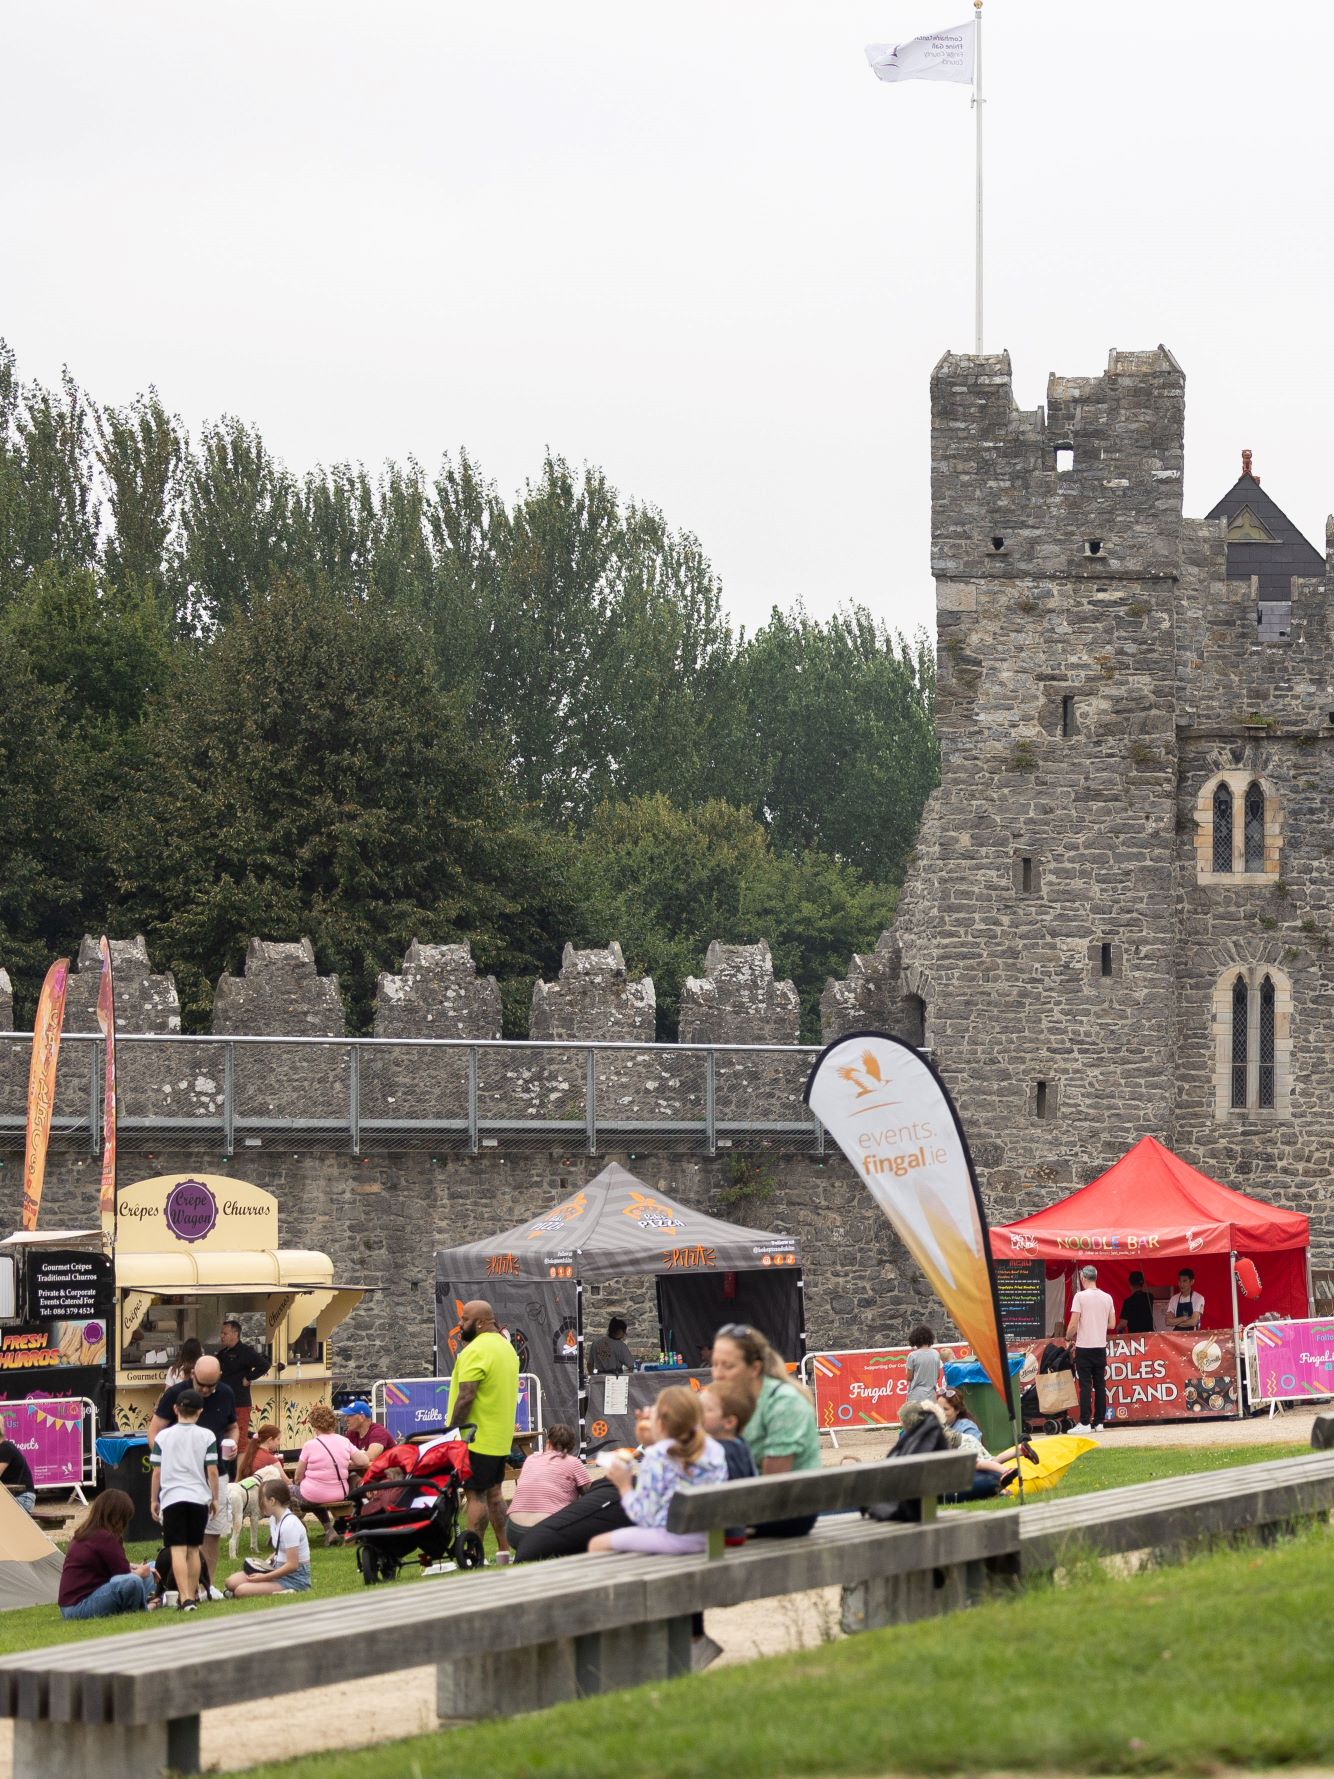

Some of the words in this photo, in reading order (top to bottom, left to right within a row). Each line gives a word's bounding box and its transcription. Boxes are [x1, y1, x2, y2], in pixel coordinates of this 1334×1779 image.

[858, 1121, 938, 1149] events.
[862, 1144, 949, 1177] fingal.ie
[119, 1201, 159, 1221] Crêpes
[223, 1200, 271, 1216] Churros
[170, 1209, 212, 1229] Wagon
[638, 1219, 687, 1229] PIZZA
[1057, 1235, 1121, 1250] NOODLE
[1127, 1234, 1160, 1249] BAR
[41, 1263, 70, 1272] Gourmet
[37, 1274, 71, 1282] Traditional
[71, 1273, 97, 1281] Churros
[38, 1289, 59, 1297] Private
[66, 1288, 96, 1298] Corporate
[40, 1298, 60, 1306] Events
[60, 1297, 83, 1305] Catered
[84, 1297, 95, 1305] For
[40, 1308, 52, 1316] Tel:
[78, 1307, 95, 1315] 4524
[3, 1333, 48, 1350] FRESH
[1106, 1337, 1145, 1357] IAN
[0, 1347, 60, 1369] HURROS
[127, 1372, 157, 1381] Gourmet
[1104, 1360, 1166, 1380] DLES
[849, 1379, 894, 1404] Fingal
[1104, 1383, 1178, 1404] YLAND
[415, 1408, 443, 1422] Fáilte
